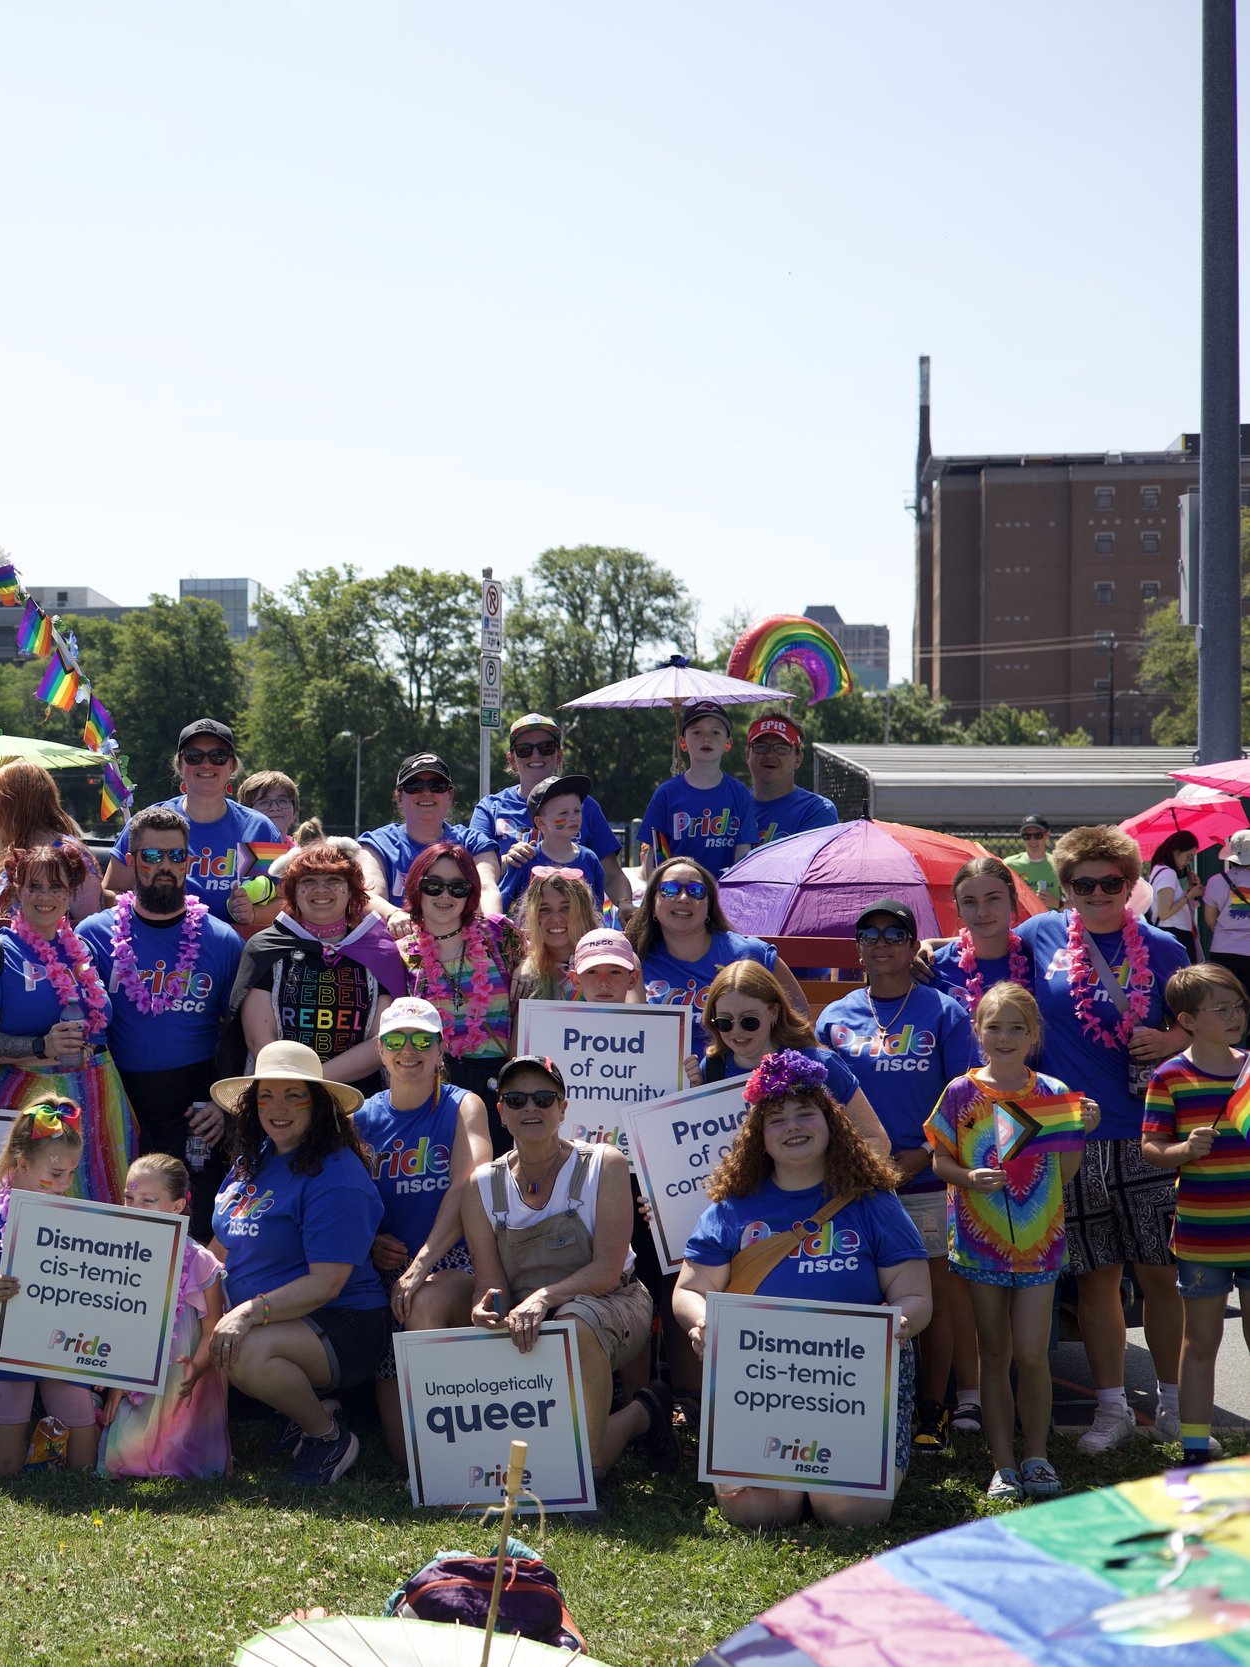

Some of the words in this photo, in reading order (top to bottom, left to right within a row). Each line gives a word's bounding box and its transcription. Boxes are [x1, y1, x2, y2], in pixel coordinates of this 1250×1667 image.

[673, 808, 741, 841] Pride
[705, 837, 735, 848] nscc
[186, 847, 237, 878] rid
[589, 939, 614, 948] nscc
[165, 999, 206, 1014] scc
[283, 984, 367, 1010] REBEL
[282, 1007, 362, 1031] REBEL
[563, 1028, 645, 1054] Proud
[831, 1024, 936, 1056] Pride
[570, 1058, 595, 1077] of
[600, 1063, 637, 1079] our
[875, 1059, 930, 1072] nscc
[565, 1082, 666, 1101] mmunity
[571, 1124, 629, 1146] Pride
[688, 1144, 710, 1167] of
[396, 1176, 449, 1195] nscc
[228, 1221, 259, 1237] nscc
[36, 1226, 153, 1262] Dismantle
[40, 1255, 142, 1288] cis-temic
[798, 1256, 859, 1273] nscc
[26, 1283, 148, 1315] oppression
[48, 1328, 111, 1358] Pride
[739, 1330, 865, 1360] Dismantle
[76, 1355, 108, 1369] nscc
[745, 1359, 856, 1387] cis-temic
[425, 1374, 553, 1397] Unapologetically
[734, 1390, 866, 1415] oppression
[426, 1399, 556, 1443] queer
[763, 1436, 831, 1463] Pride
[469, 1465, 532, 1488] Prie
[794, 1461, 829, 1474] nscc
